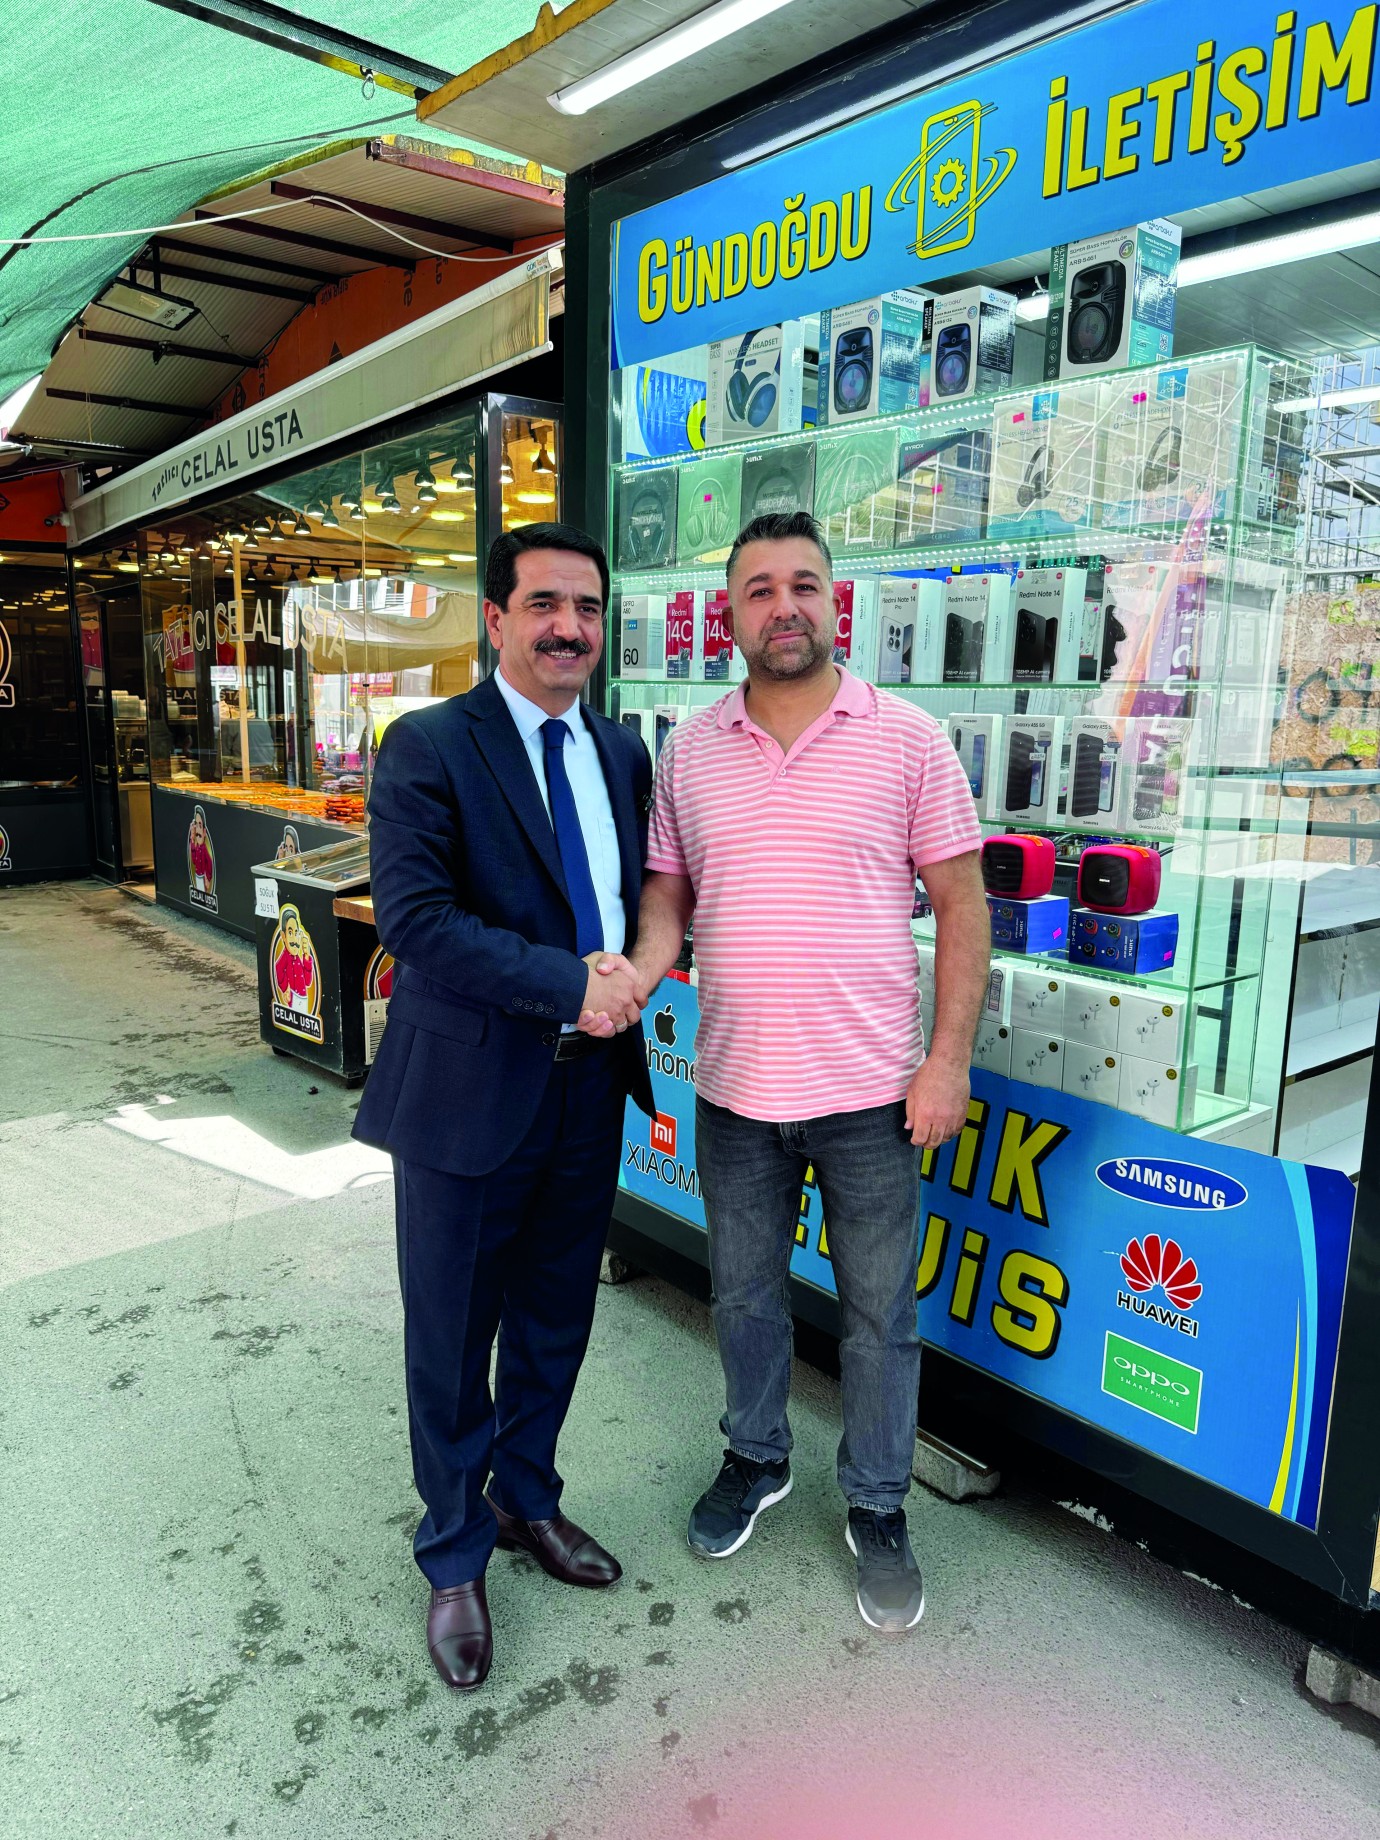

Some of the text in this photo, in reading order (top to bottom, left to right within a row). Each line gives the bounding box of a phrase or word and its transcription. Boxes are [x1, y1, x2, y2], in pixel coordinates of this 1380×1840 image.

[638, 3, 1378, 324] GÜNDOĞDU İLETİŞİM
[752, 337, 779, 350] HEADSET
[181, 440, 238, 488] CELAL
[247, 408, 303, 459] USTA
[1018, 589, 1061, 599] Redmi Note 14
[672, 608, 688, 617] Redmi
[153, 598, 349, 674] TATLICI CELAL USTA
[667, 620, 692, 642] 14C
[623, 648, 639, 666] 60
[190, 888, 205, 904] CELAL
[259, 886, 276, 899] SOĞUK
[274, 1007, 320, 1033] CELAL USTA
[1115, 1158, 1226, 1210] SAMSUNG
[1116, 1290, 1200, 1339] HUAWEI
[1119, 1375, 1181, 1409] SMARTPHONE
